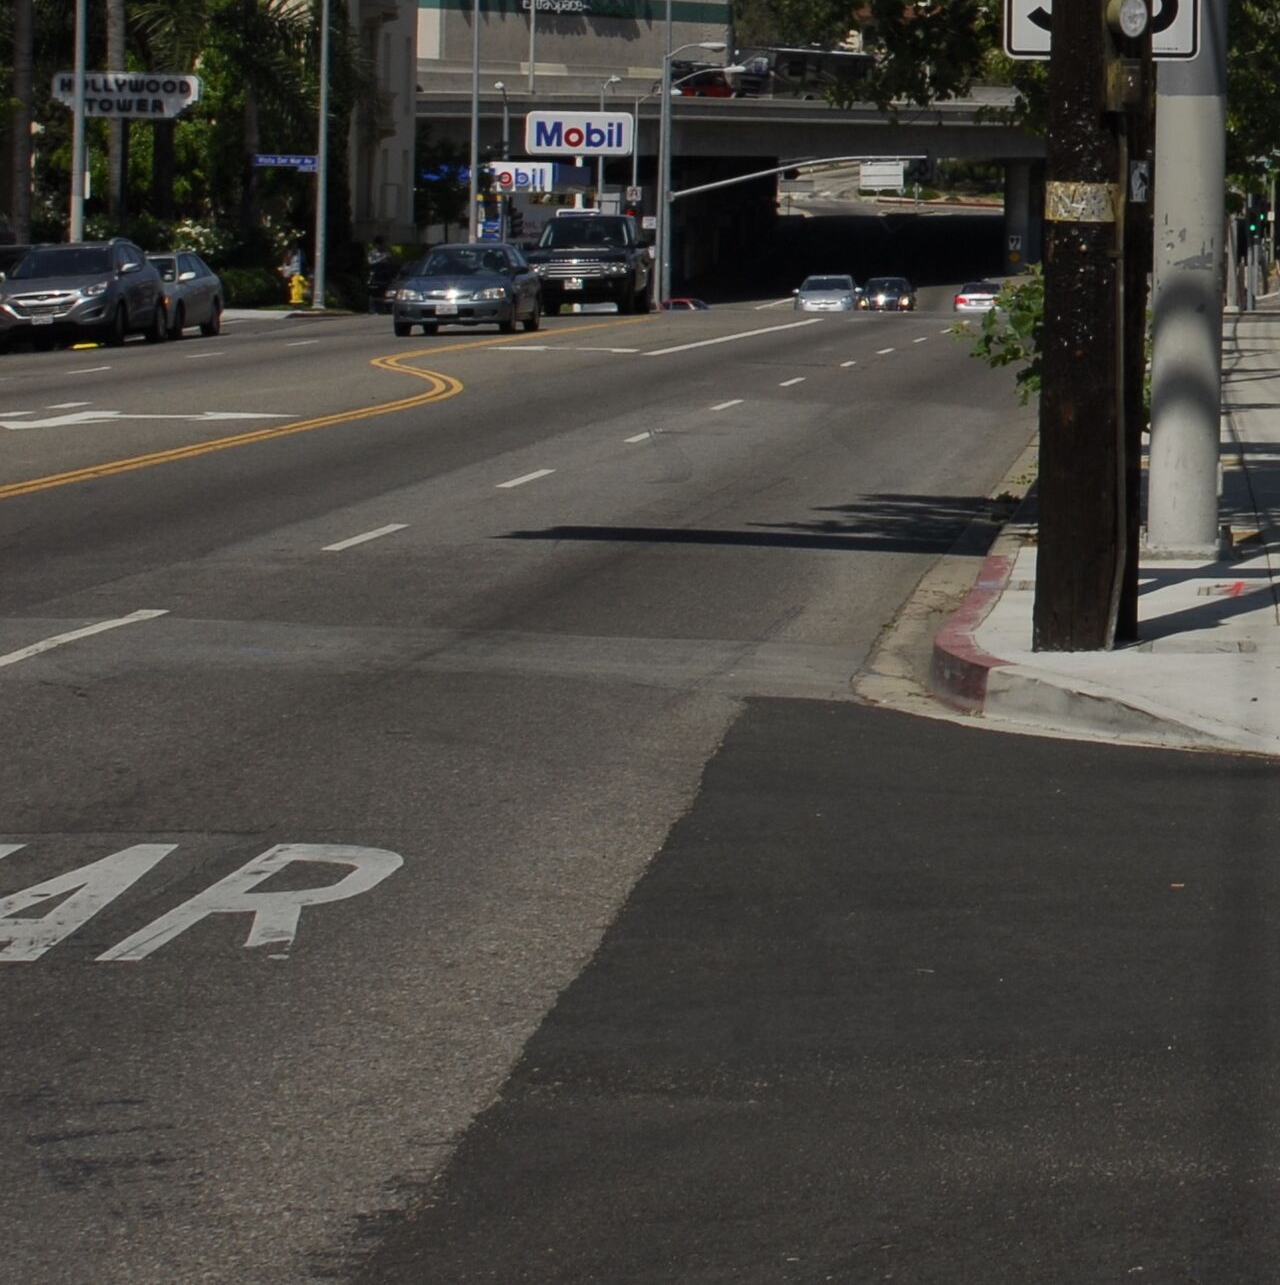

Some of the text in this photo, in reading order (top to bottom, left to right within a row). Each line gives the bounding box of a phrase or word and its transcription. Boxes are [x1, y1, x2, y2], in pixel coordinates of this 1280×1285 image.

[60, 78, 192, 95] HLLYWOOD
[85, 98, 165, 113] TOWER
[535, 121, 623, 148] Mobil
[488, 168, 546, 188] obil
